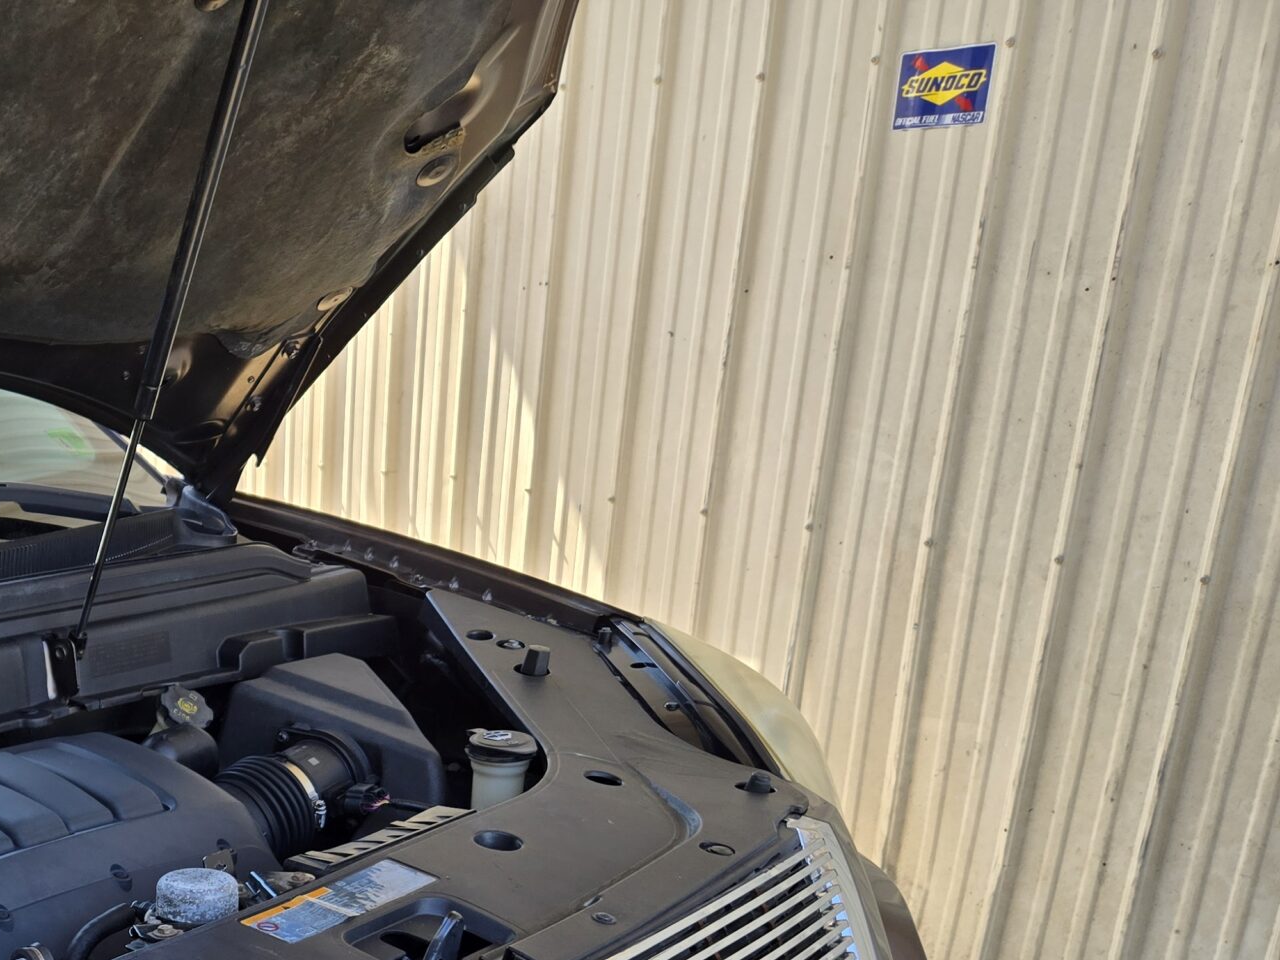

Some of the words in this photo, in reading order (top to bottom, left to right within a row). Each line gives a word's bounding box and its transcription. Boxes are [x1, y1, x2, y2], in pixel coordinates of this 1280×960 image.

[905, 71, 983, 95] SUNOCO
[921, 114, 939, 124] FUEL
[951, 112, 982, 123] NASCAR
